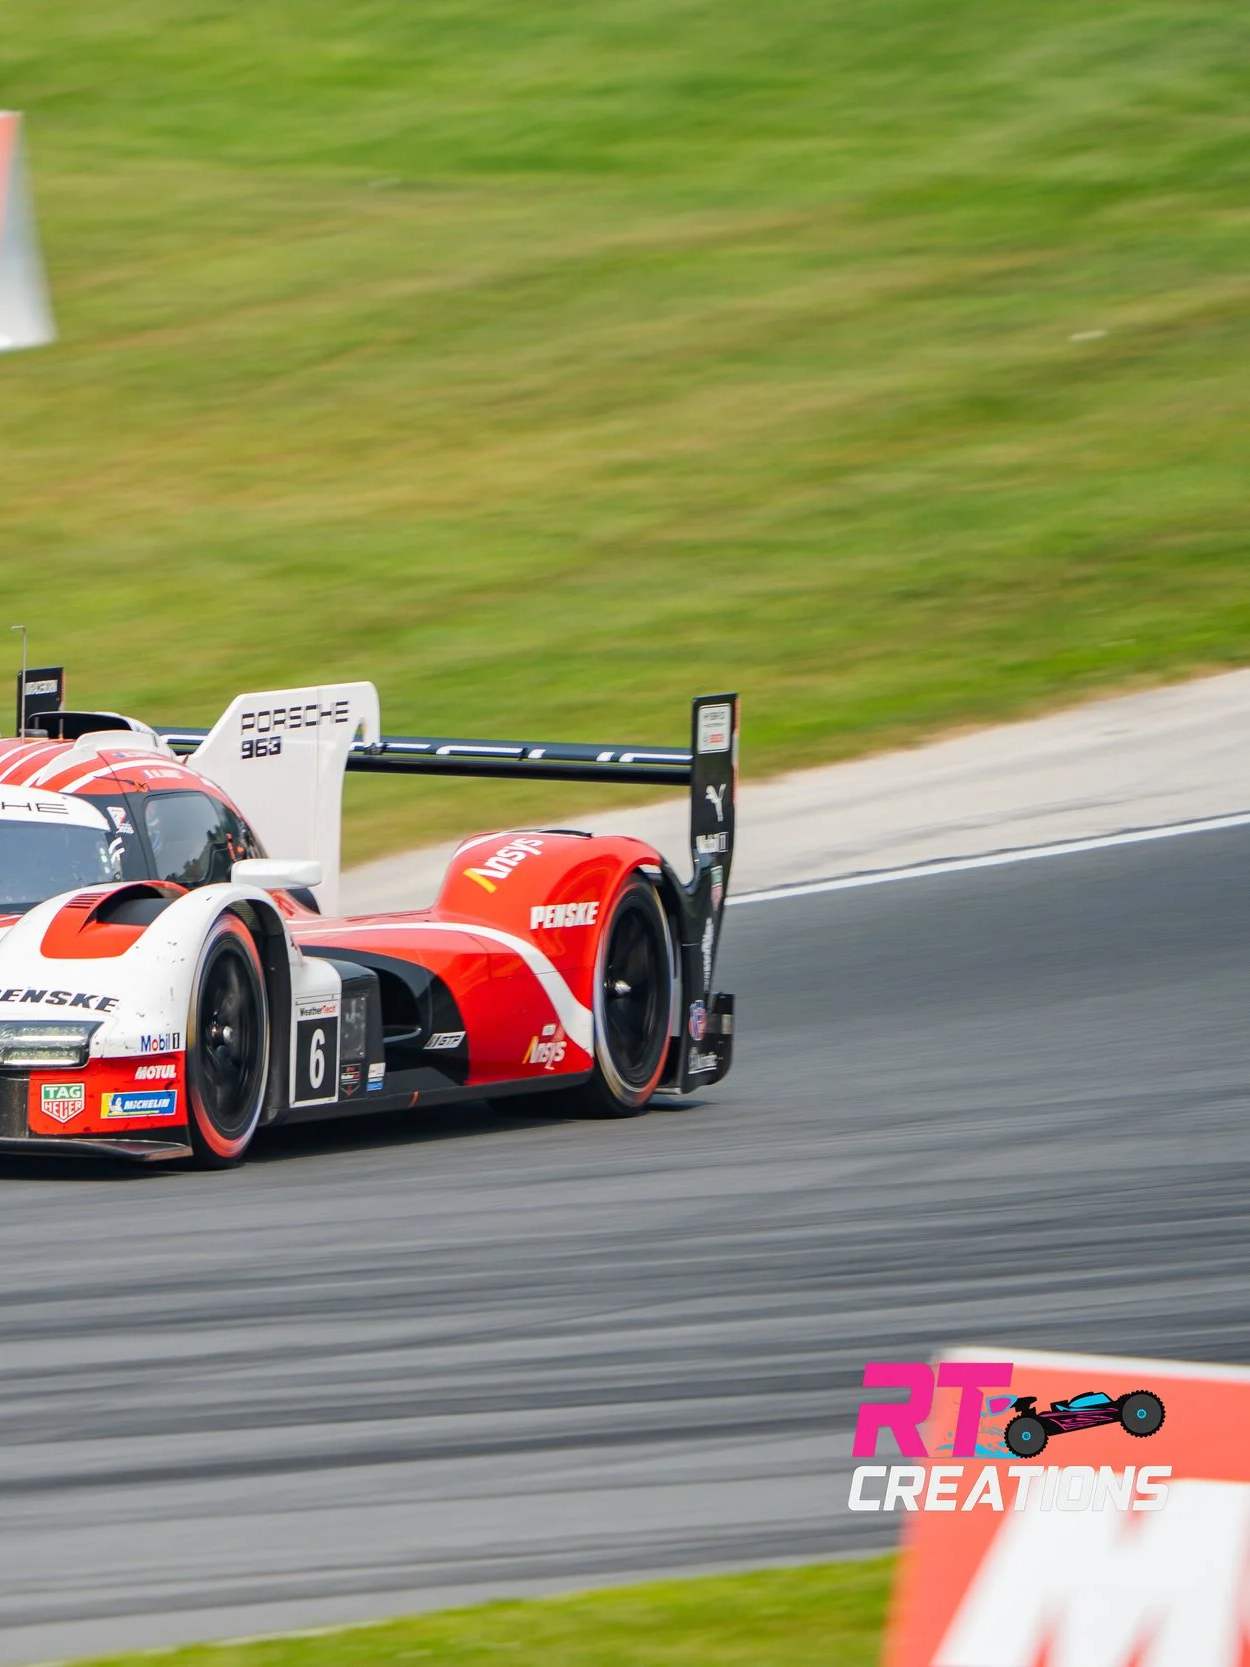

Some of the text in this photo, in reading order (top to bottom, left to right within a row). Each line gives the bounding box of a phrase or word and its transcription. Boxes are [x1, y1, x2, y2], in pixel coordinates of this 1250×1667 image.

[241, 701, 349, 735] PORSCHE
[241, 736, 281, 759] 963
[463, 838, 544, 893] Ansys
[530, 901, 600, 930] PENSKE
[141, 1032, 180, 1052] Mobil 1
[309, 1028, 325, 1089] 6
[134, 1065, 177, 1080] MOTUL
[45, 1086, 81, 1098] TAG
[44, 1101, 83, 1120] HEUER
[124, 1098, 170, 1110] MICHELIN
